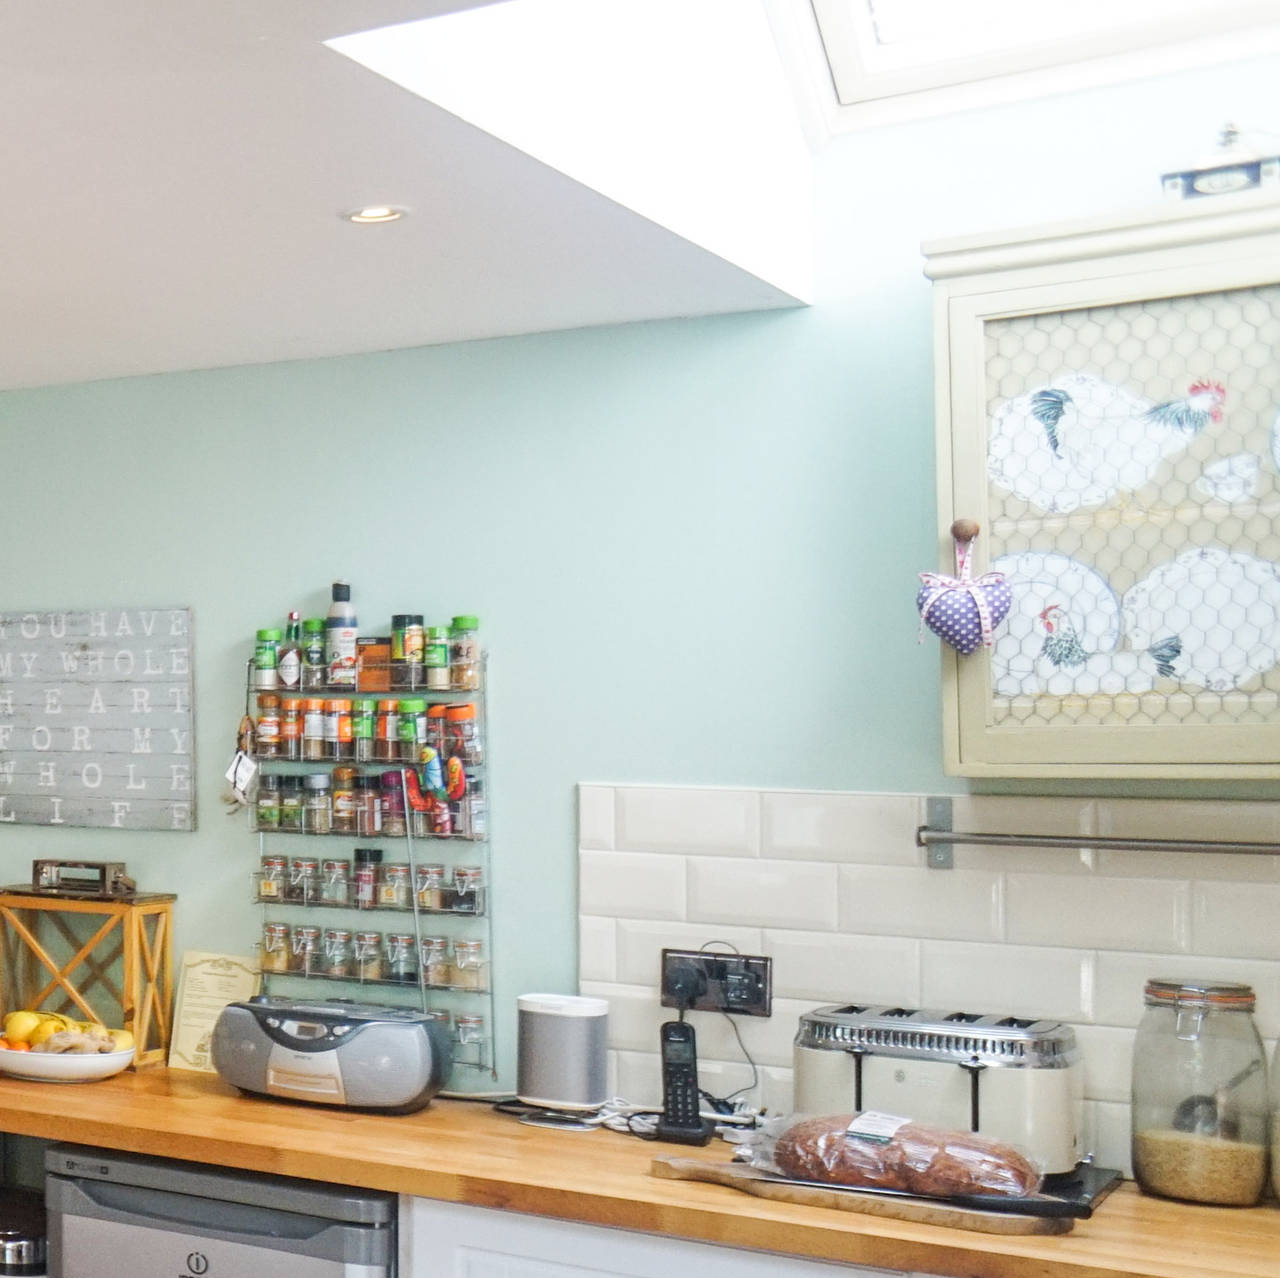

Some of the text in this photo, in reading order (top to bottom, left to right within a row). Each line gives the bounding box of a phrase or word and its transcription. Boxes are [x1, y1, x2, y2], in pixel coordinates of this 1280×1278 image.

[90, 610, 188, 637] HAVE
[61, 649, 189, 675] WHOLE
[132, 728, 188, 754] MY
